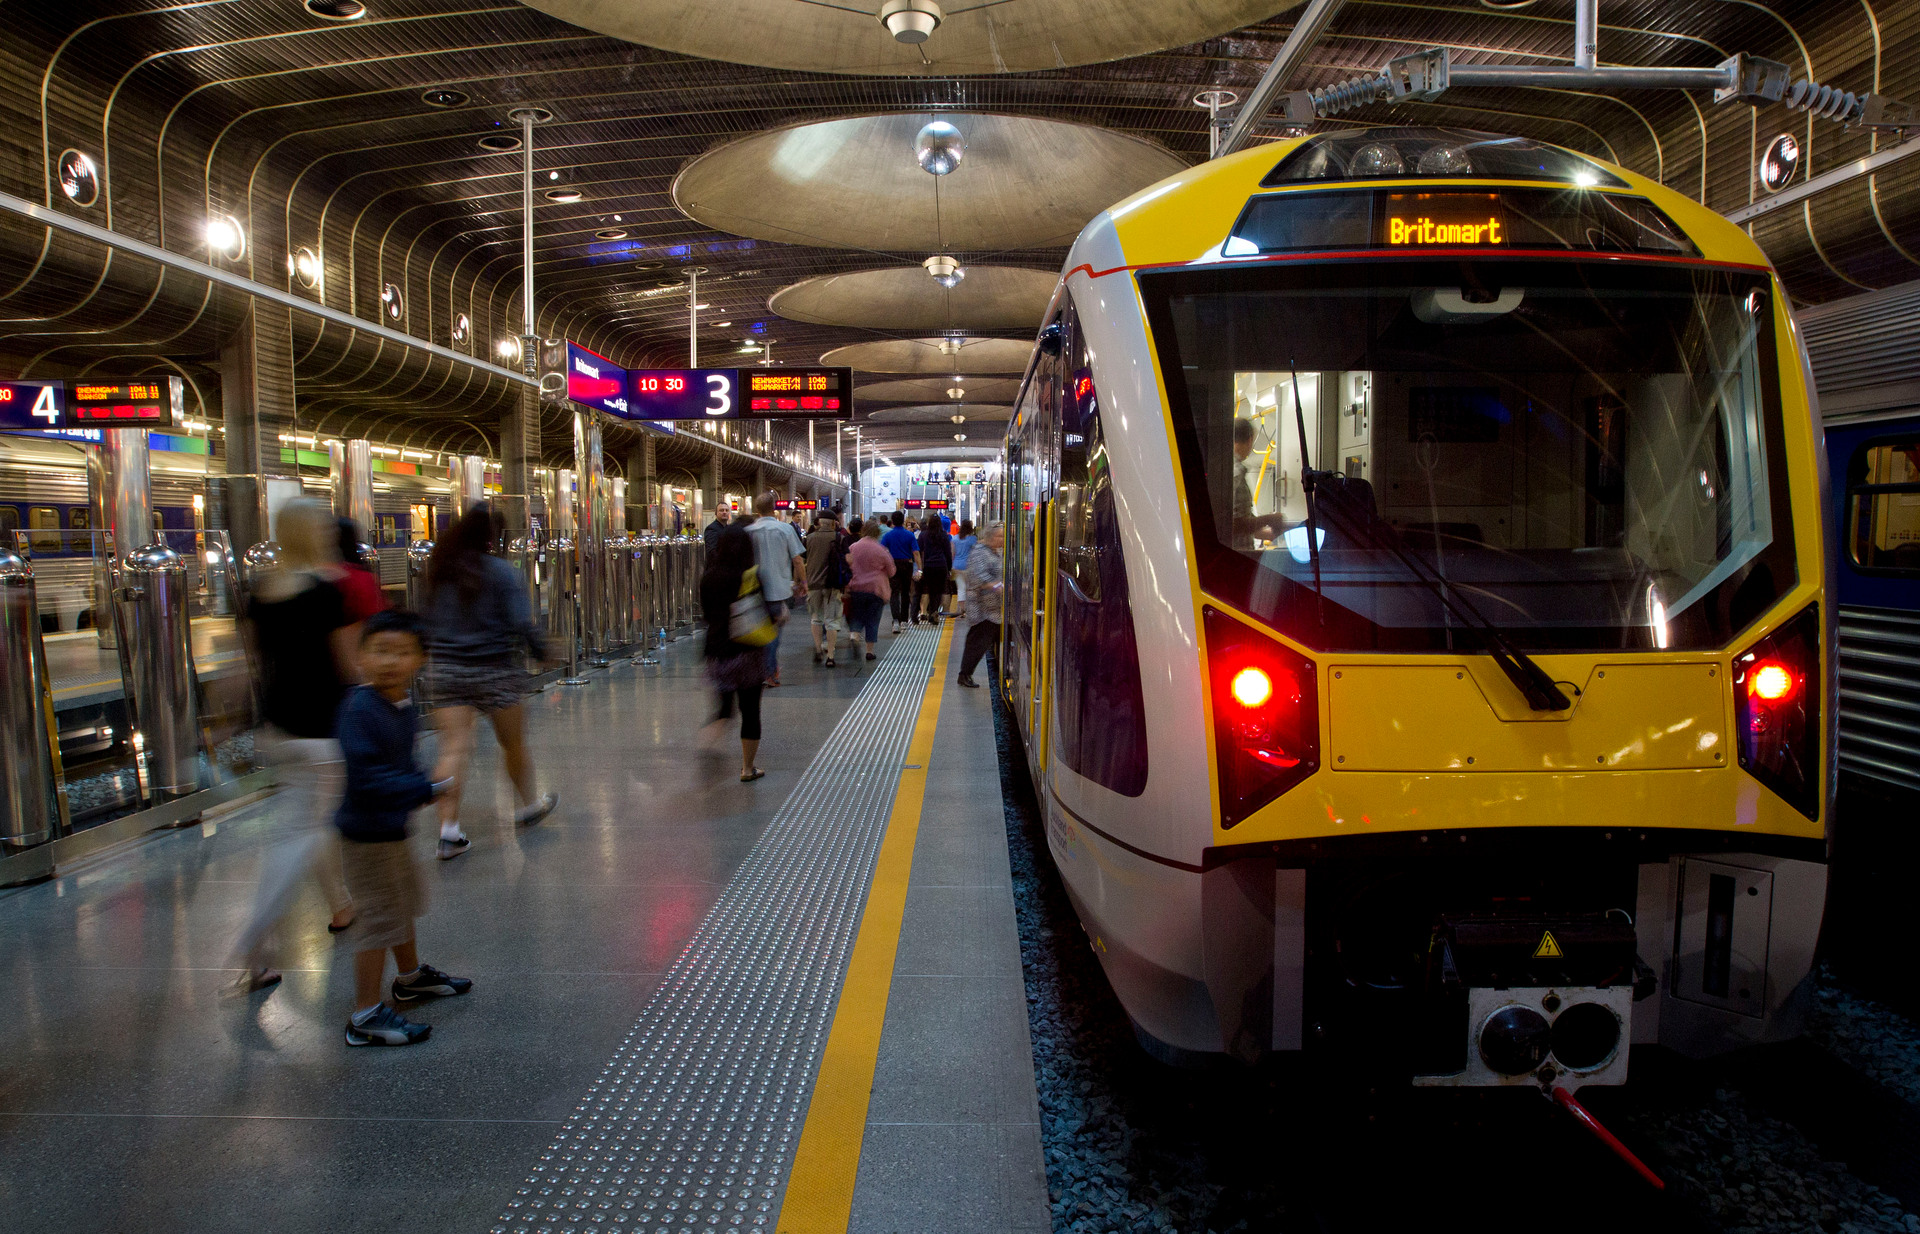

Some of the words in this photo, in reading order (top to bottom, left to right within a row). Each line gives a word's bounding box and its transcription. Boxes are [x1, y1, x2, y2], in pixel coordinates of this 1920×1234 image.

[1390, 218, 1502, 244] Britomart
[641, 378, 658, 391] 10
[665, 378, 684, 391] 30
[808, 376, 827, 384] 1040
[129, 385, 147, 393] 1041
[149, 385, 159, 393] 11
[130, 392, 148, 400] 1103
[705, 374, 731, 415] 3
[31, 385, 60, 425] 4
[788, 501, 796, 509] 4
[920, 500, 927, 509] 3
